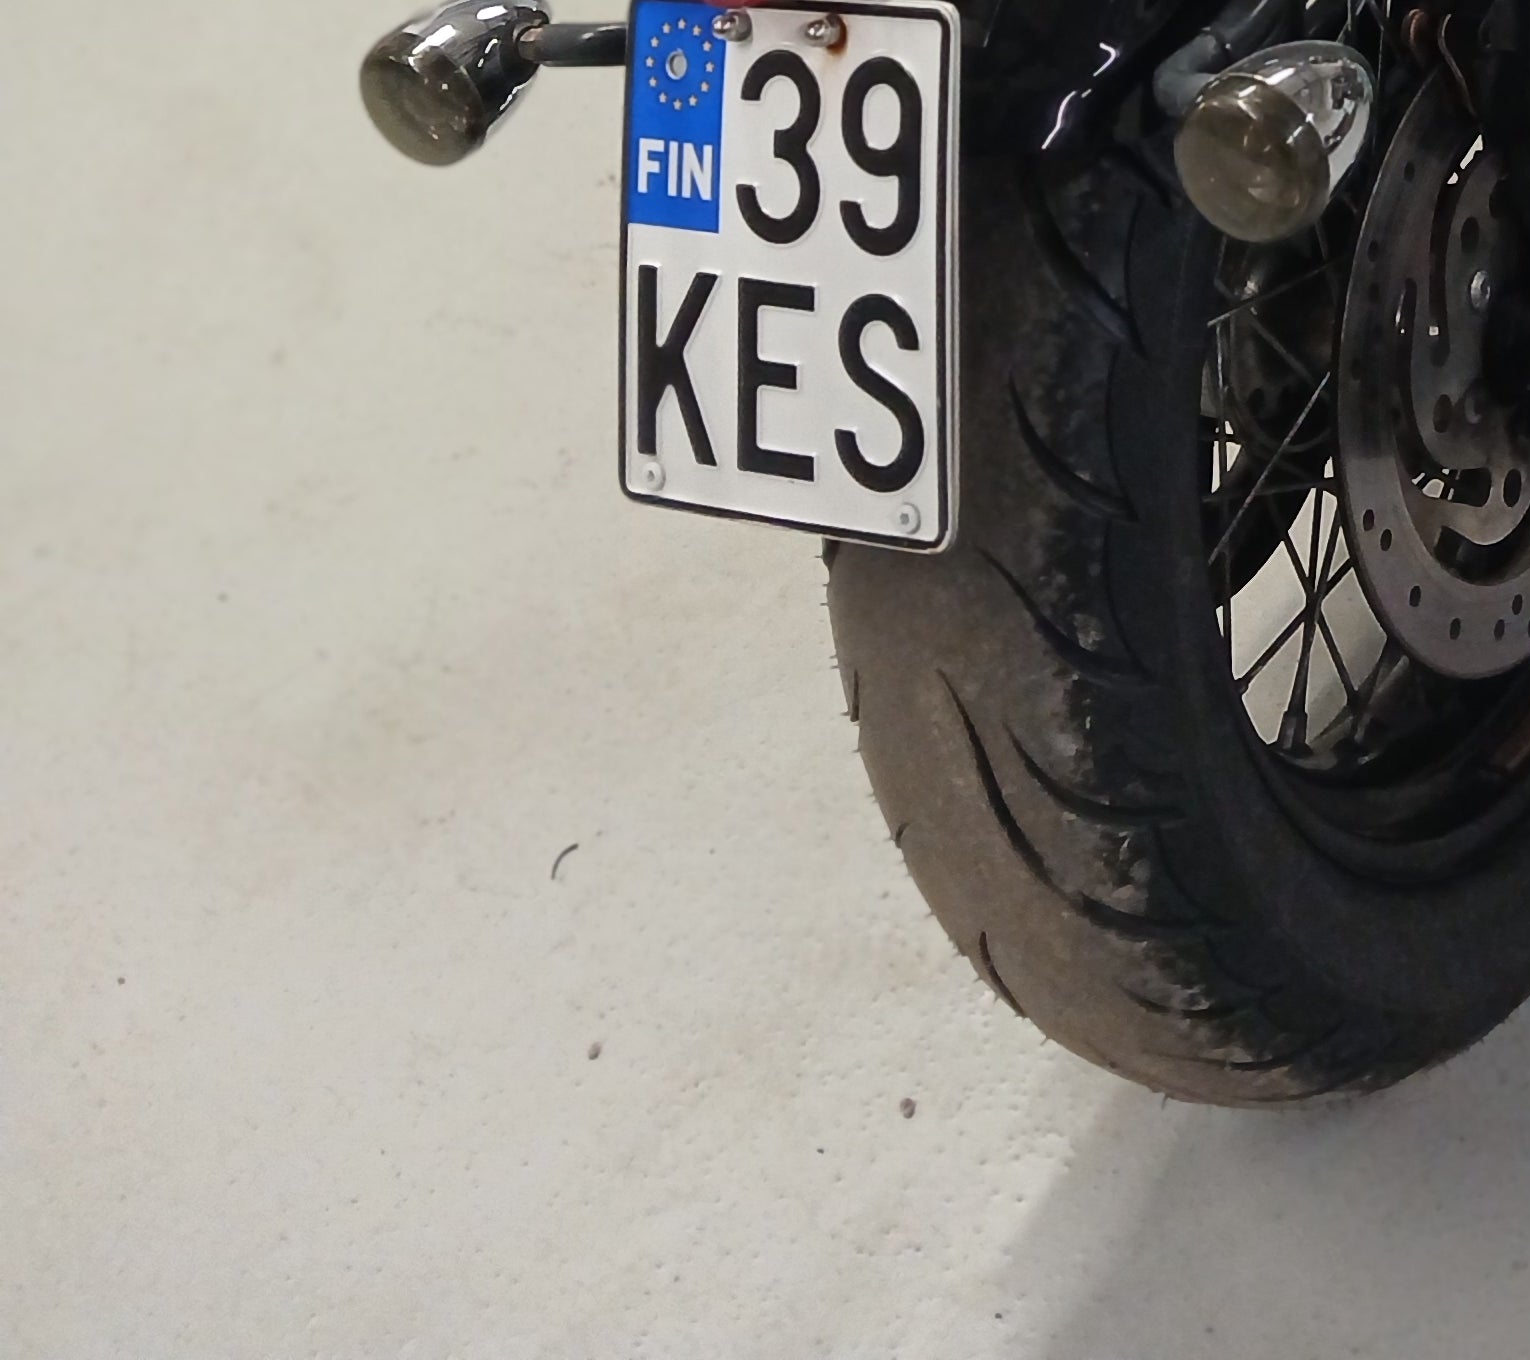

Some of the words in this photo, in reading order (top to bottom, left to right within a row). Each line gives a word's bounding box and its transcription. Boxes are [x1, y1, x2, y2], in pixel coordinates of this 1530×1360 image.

[636, 137, 713, 201] FIN
[735, 49, 923, 257] 39
[637, 263, 925, 493] KES
